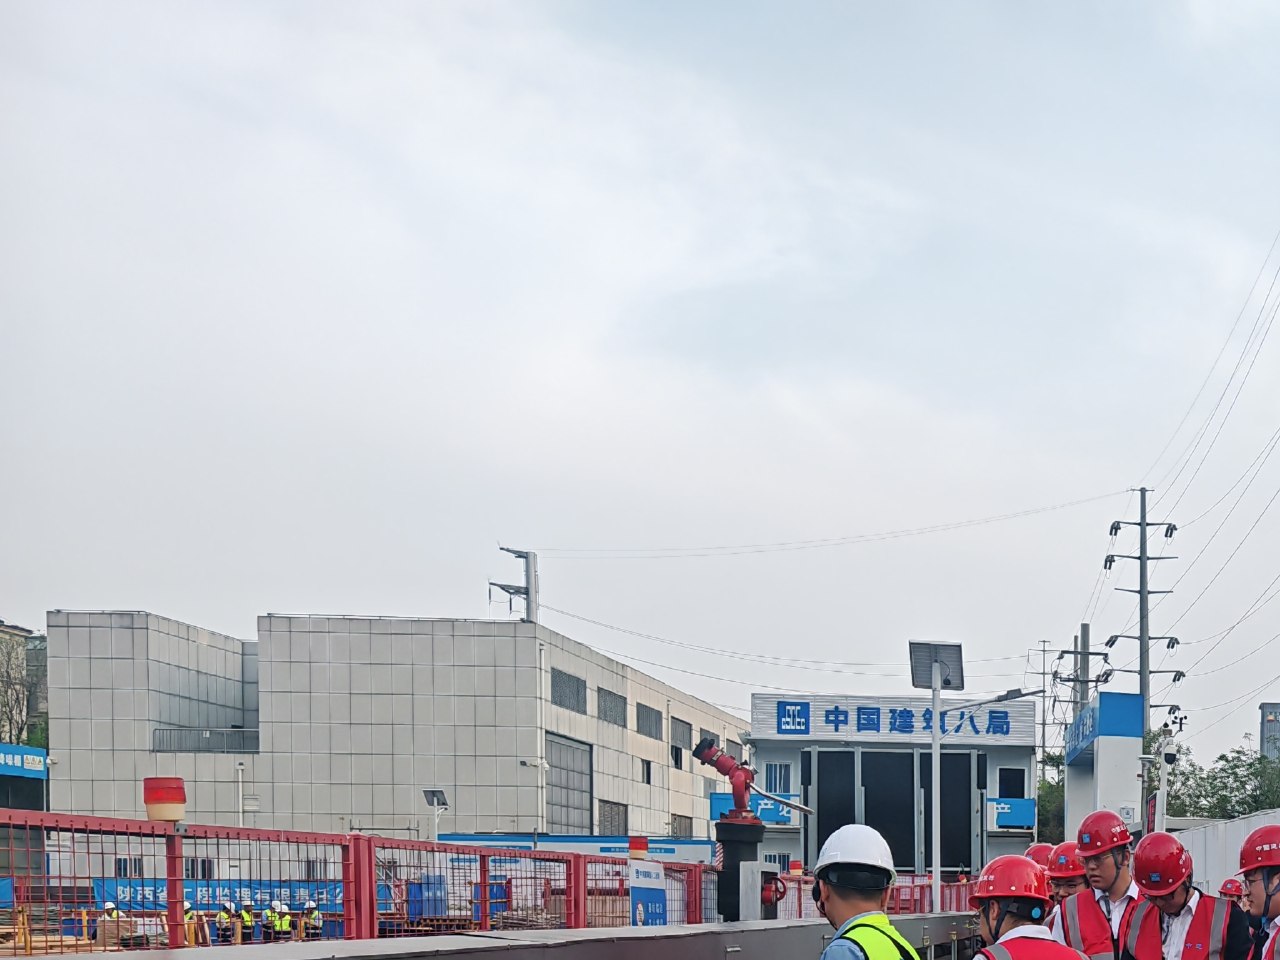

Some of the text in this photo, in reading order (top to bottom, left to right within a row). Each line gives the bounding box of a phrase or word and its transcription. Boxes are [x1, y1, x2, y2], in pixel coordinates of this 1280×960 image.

[824, 705, 1011, 736] 中国建筑八局
